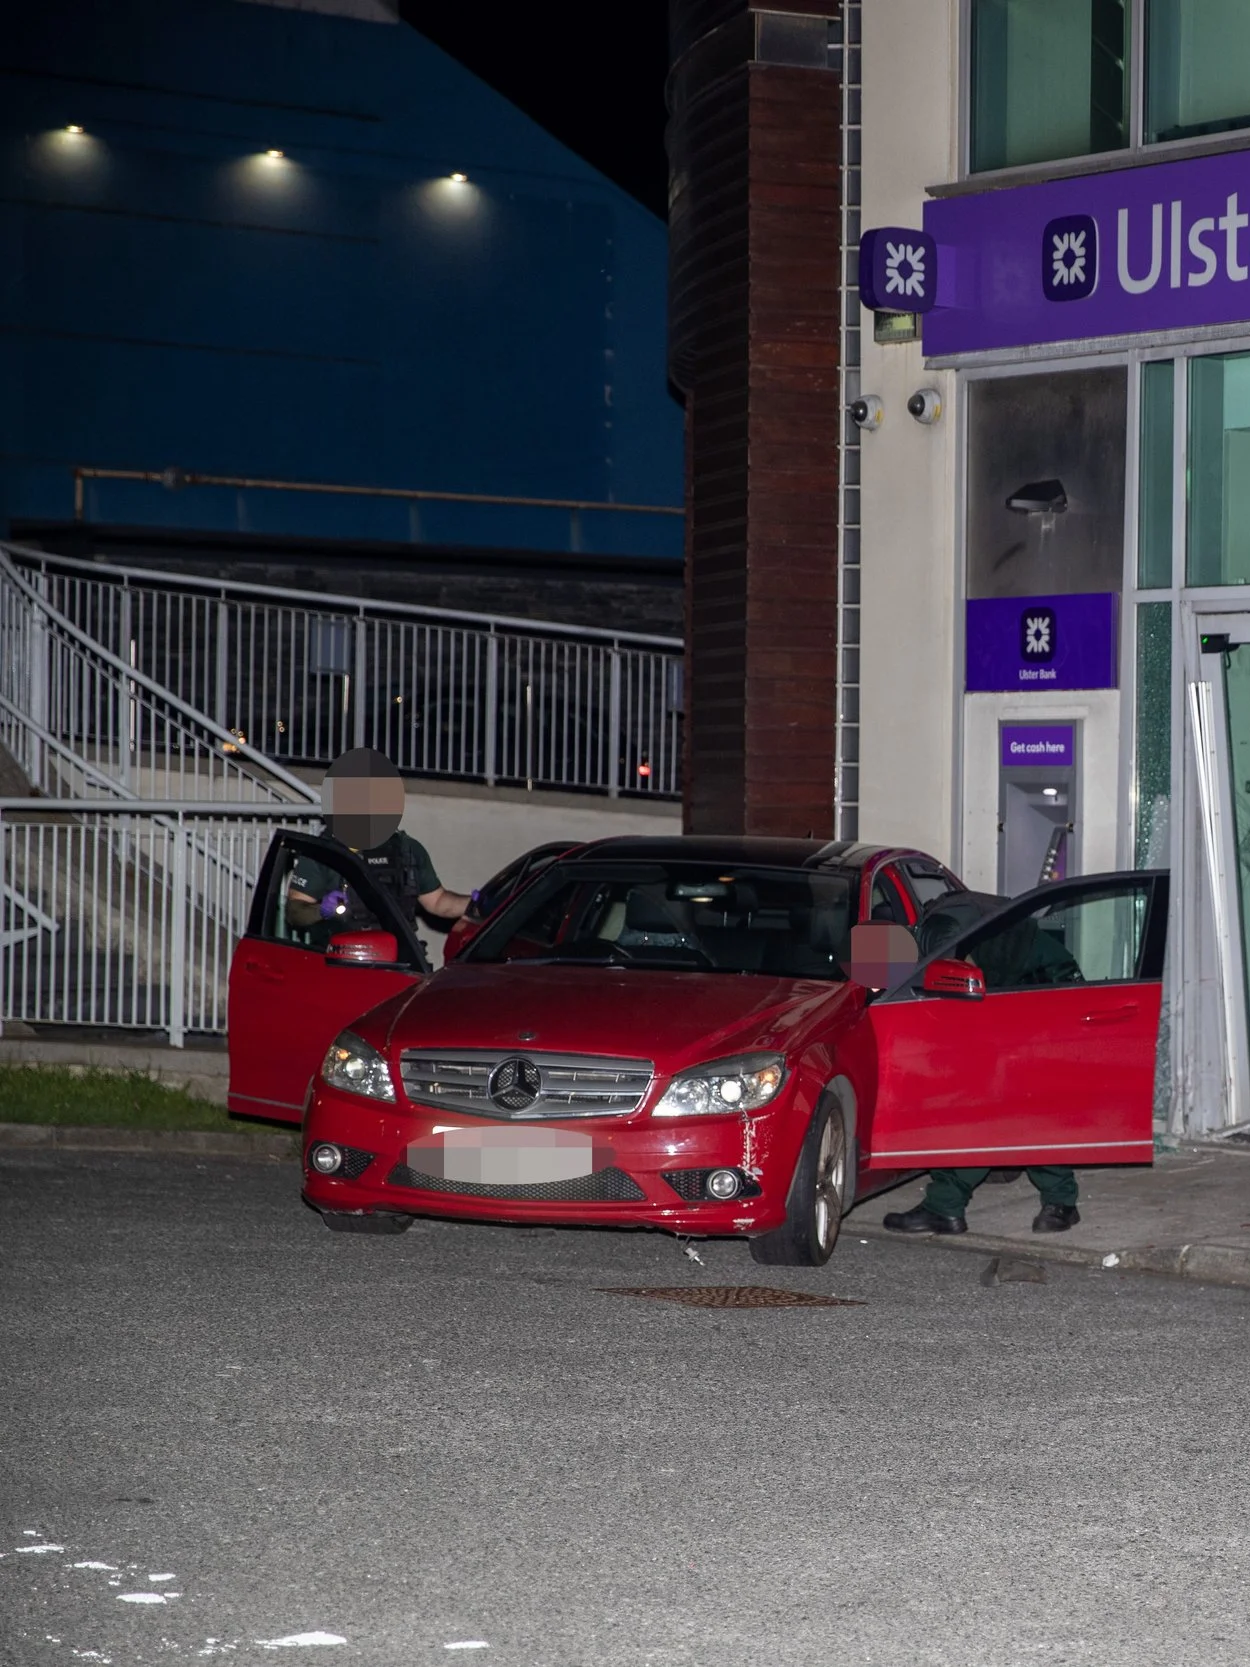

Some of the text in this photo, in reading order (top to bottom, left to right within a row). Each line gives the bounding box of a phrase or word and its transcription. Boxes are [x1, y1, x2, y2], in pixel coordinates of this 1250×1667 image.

[1019, 668, 1057, 680] Ulster Bank
[1010, 741, 1065, 754] Get cash here
[367, 856, 389, 864] POLICE
